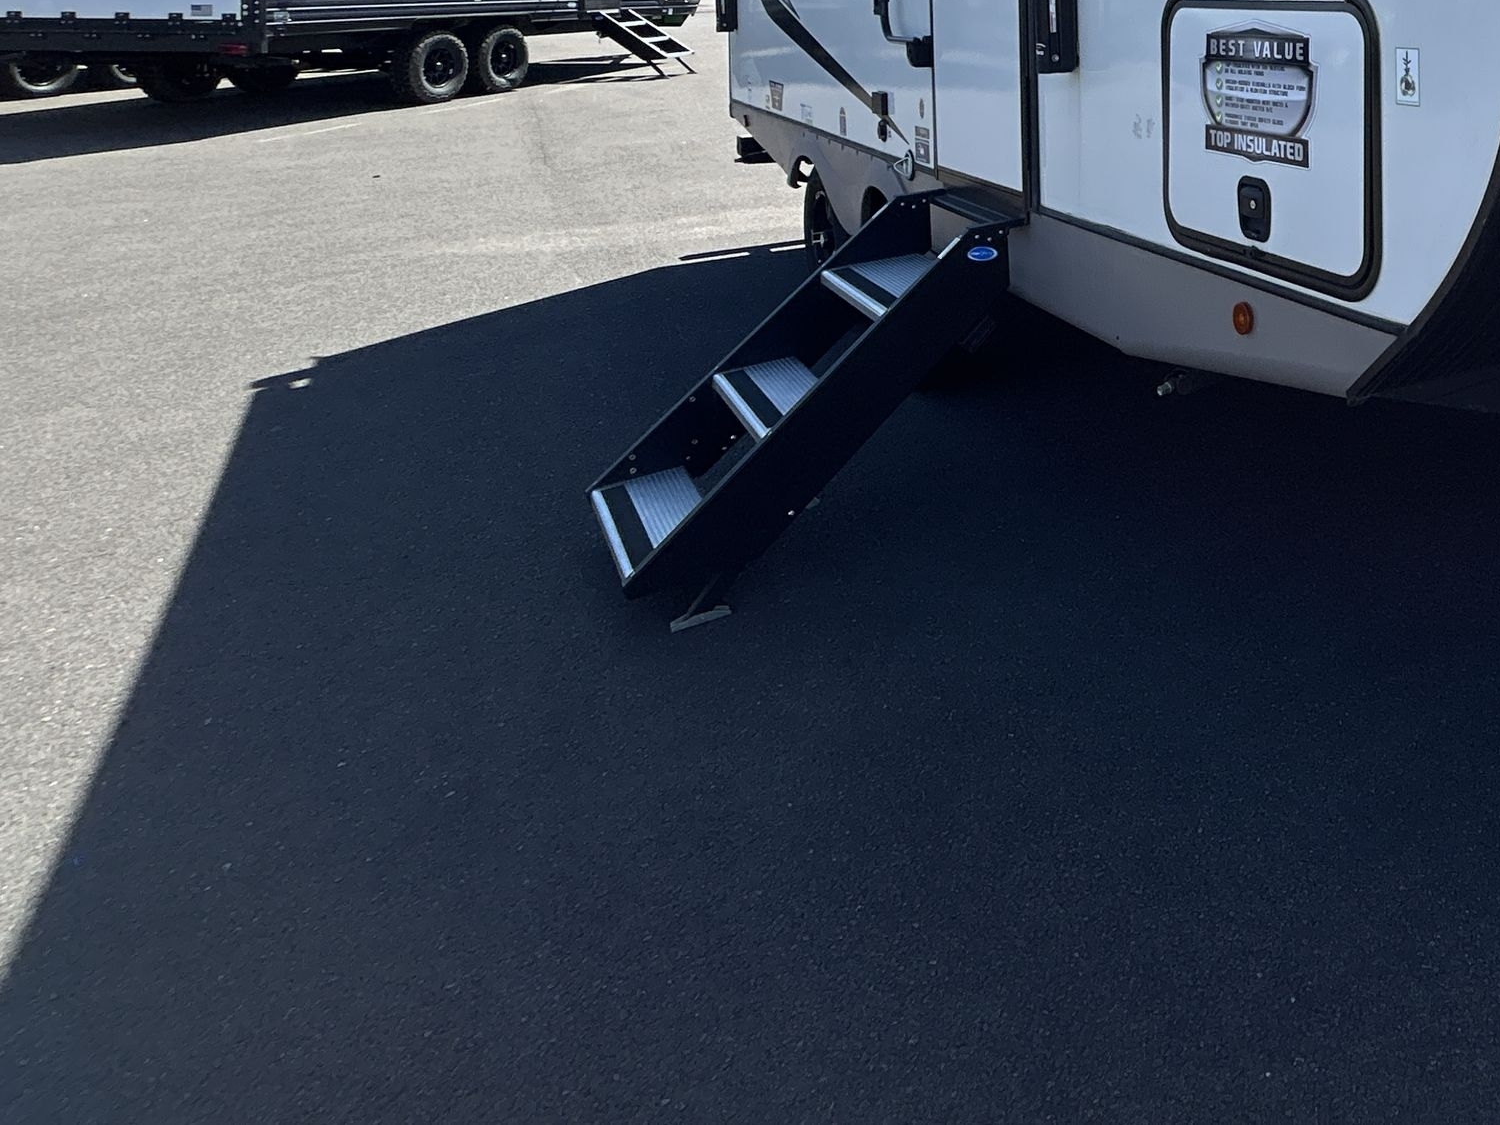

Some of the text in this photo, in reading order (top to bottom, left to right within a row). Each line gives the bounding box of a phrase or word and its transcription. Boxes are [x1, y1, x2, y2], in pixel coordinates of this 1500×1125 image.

[1209, 39, 1304, 61] BEST VALUE
[1209, 130, 1304, 161] TOP INSULATED
